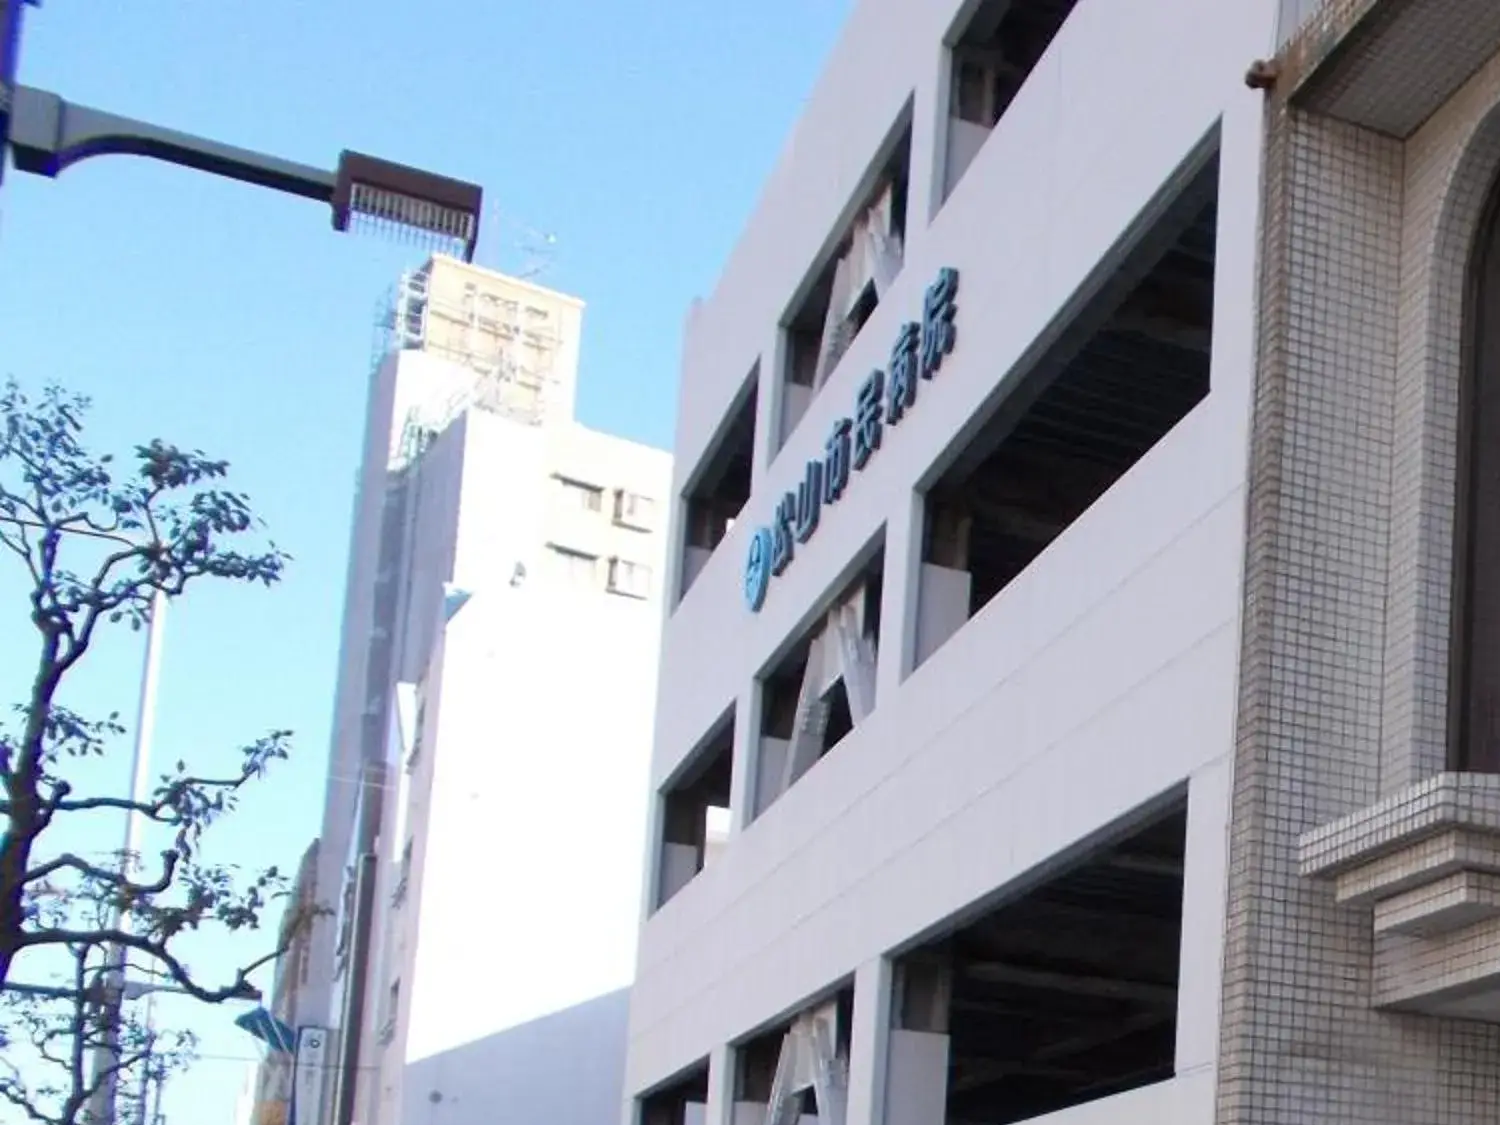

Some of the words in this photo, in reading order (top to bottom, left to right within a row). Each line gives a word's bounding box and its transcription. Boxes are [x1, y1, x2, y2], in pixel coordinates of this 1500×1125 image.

[771, 267, 959, 577] 松山市民病院
